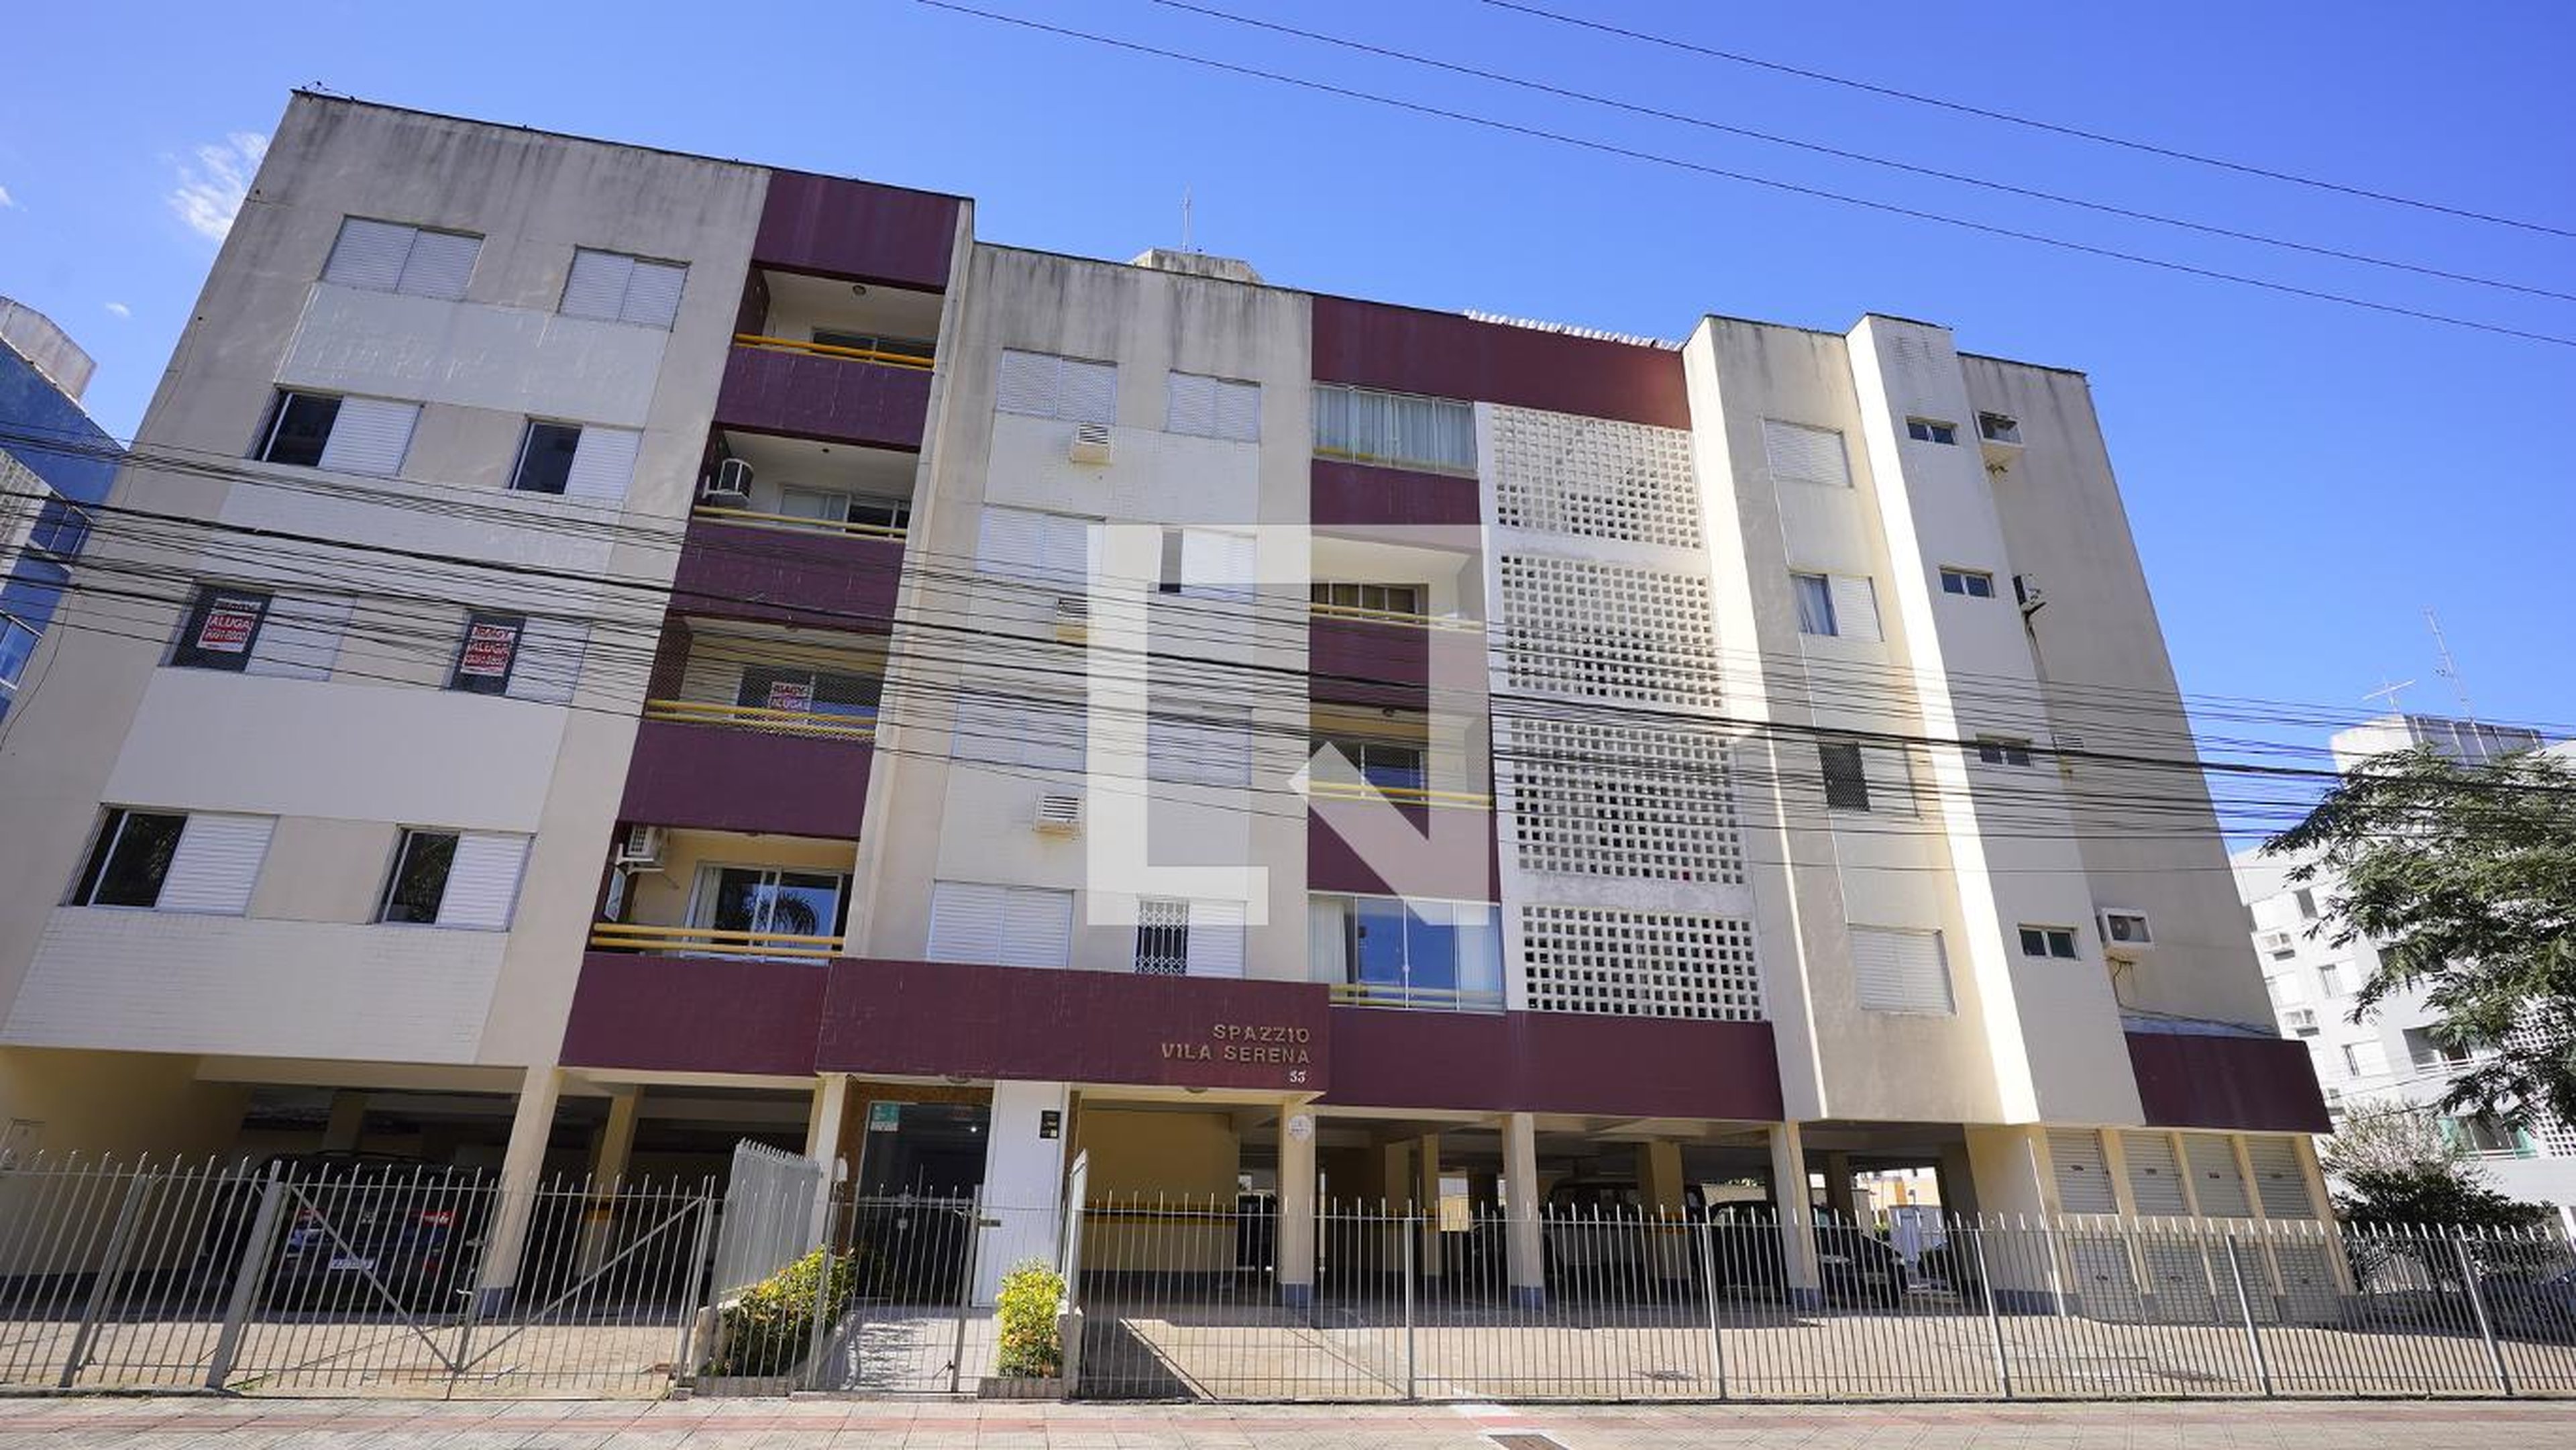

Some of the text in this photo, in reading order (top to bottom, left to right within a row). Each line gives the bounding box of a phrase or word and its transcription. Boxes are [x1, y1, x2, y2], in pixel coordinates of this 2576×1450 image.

[209, 616, 252, 629] ALUGA
[1213, 1023, 1309, 1043] SPAZZIO
[1161, 1043, 1309, 1064] VILA SERENA
